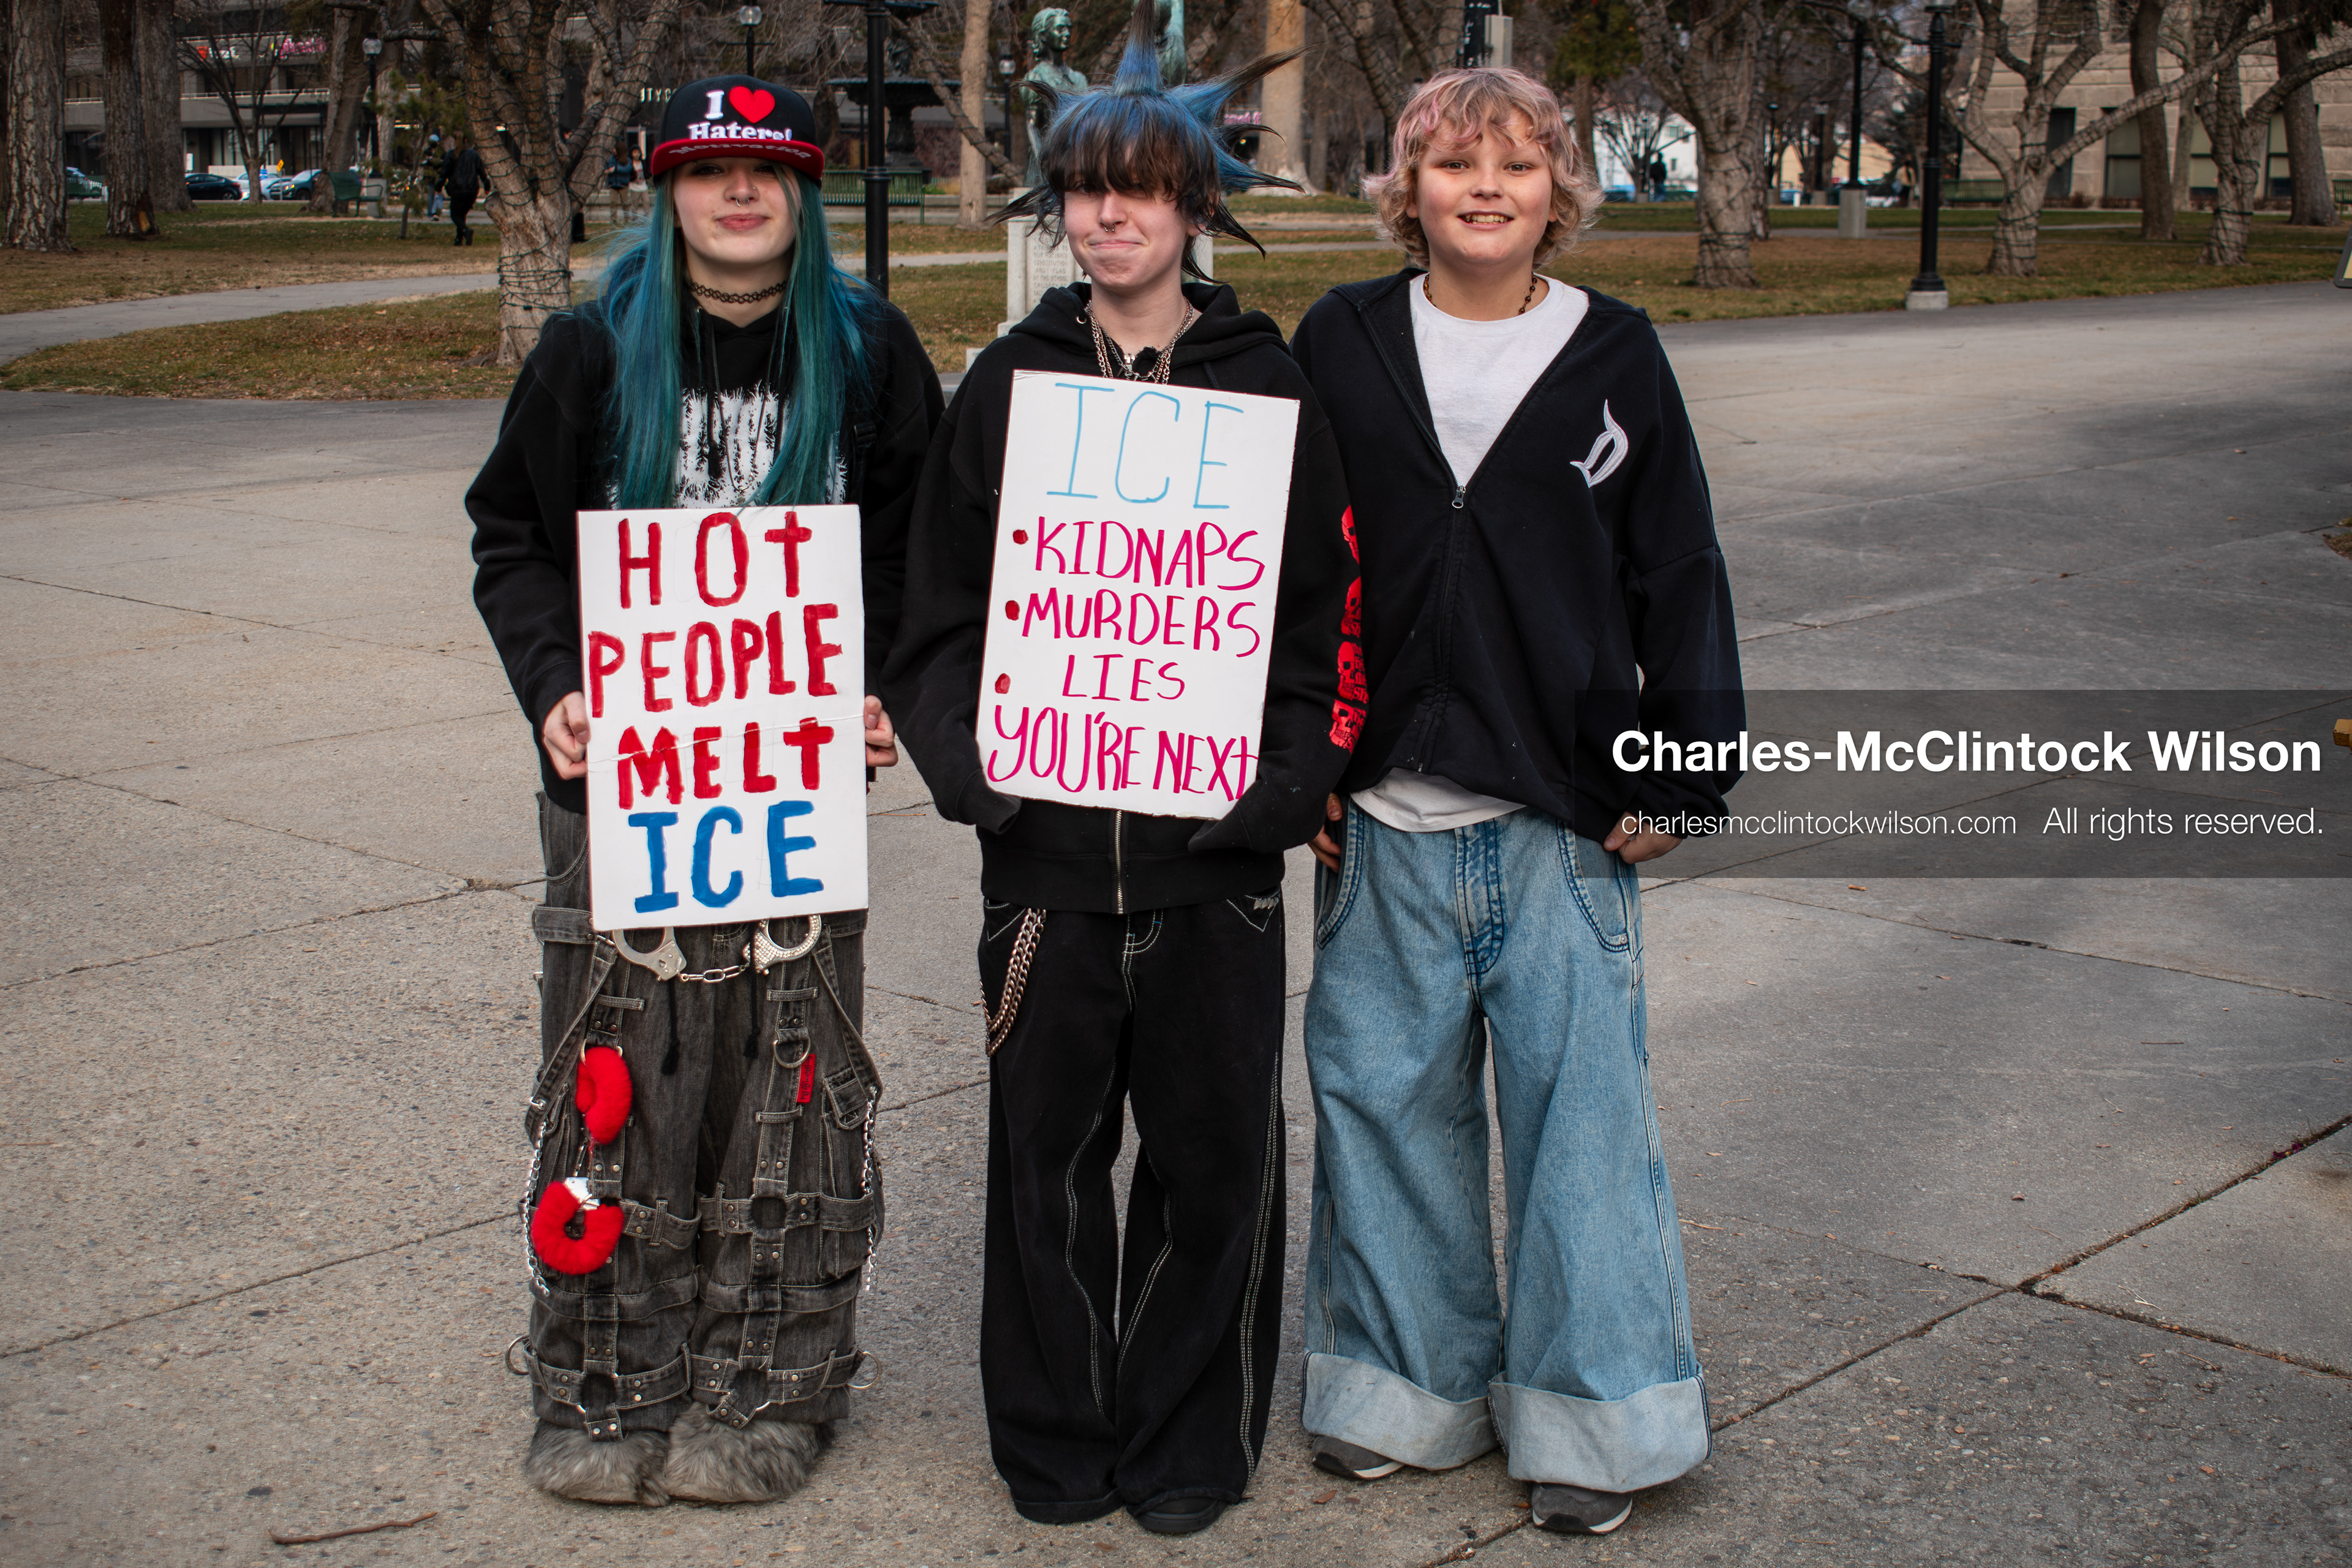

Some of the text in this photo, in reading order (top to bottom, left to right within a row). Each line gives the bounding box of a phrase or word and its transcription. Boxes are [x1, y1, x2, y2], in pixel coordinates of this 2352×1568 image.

[688, 121, 792, 141] Haters!
[705, 90, 725, 120] I
[1047, 383, 1244, 509] ICE
[1035, 516, 1265, 591] KIDNAPS
[1022, 587, 1260, 657] MURDERS
[588, 603, 843, 718] PEOPLE
[1063, 654, 1185, 701] LIES
[987, 705, 1146, 793] YOU'RE
[628, 801, 824, 913] ICE
